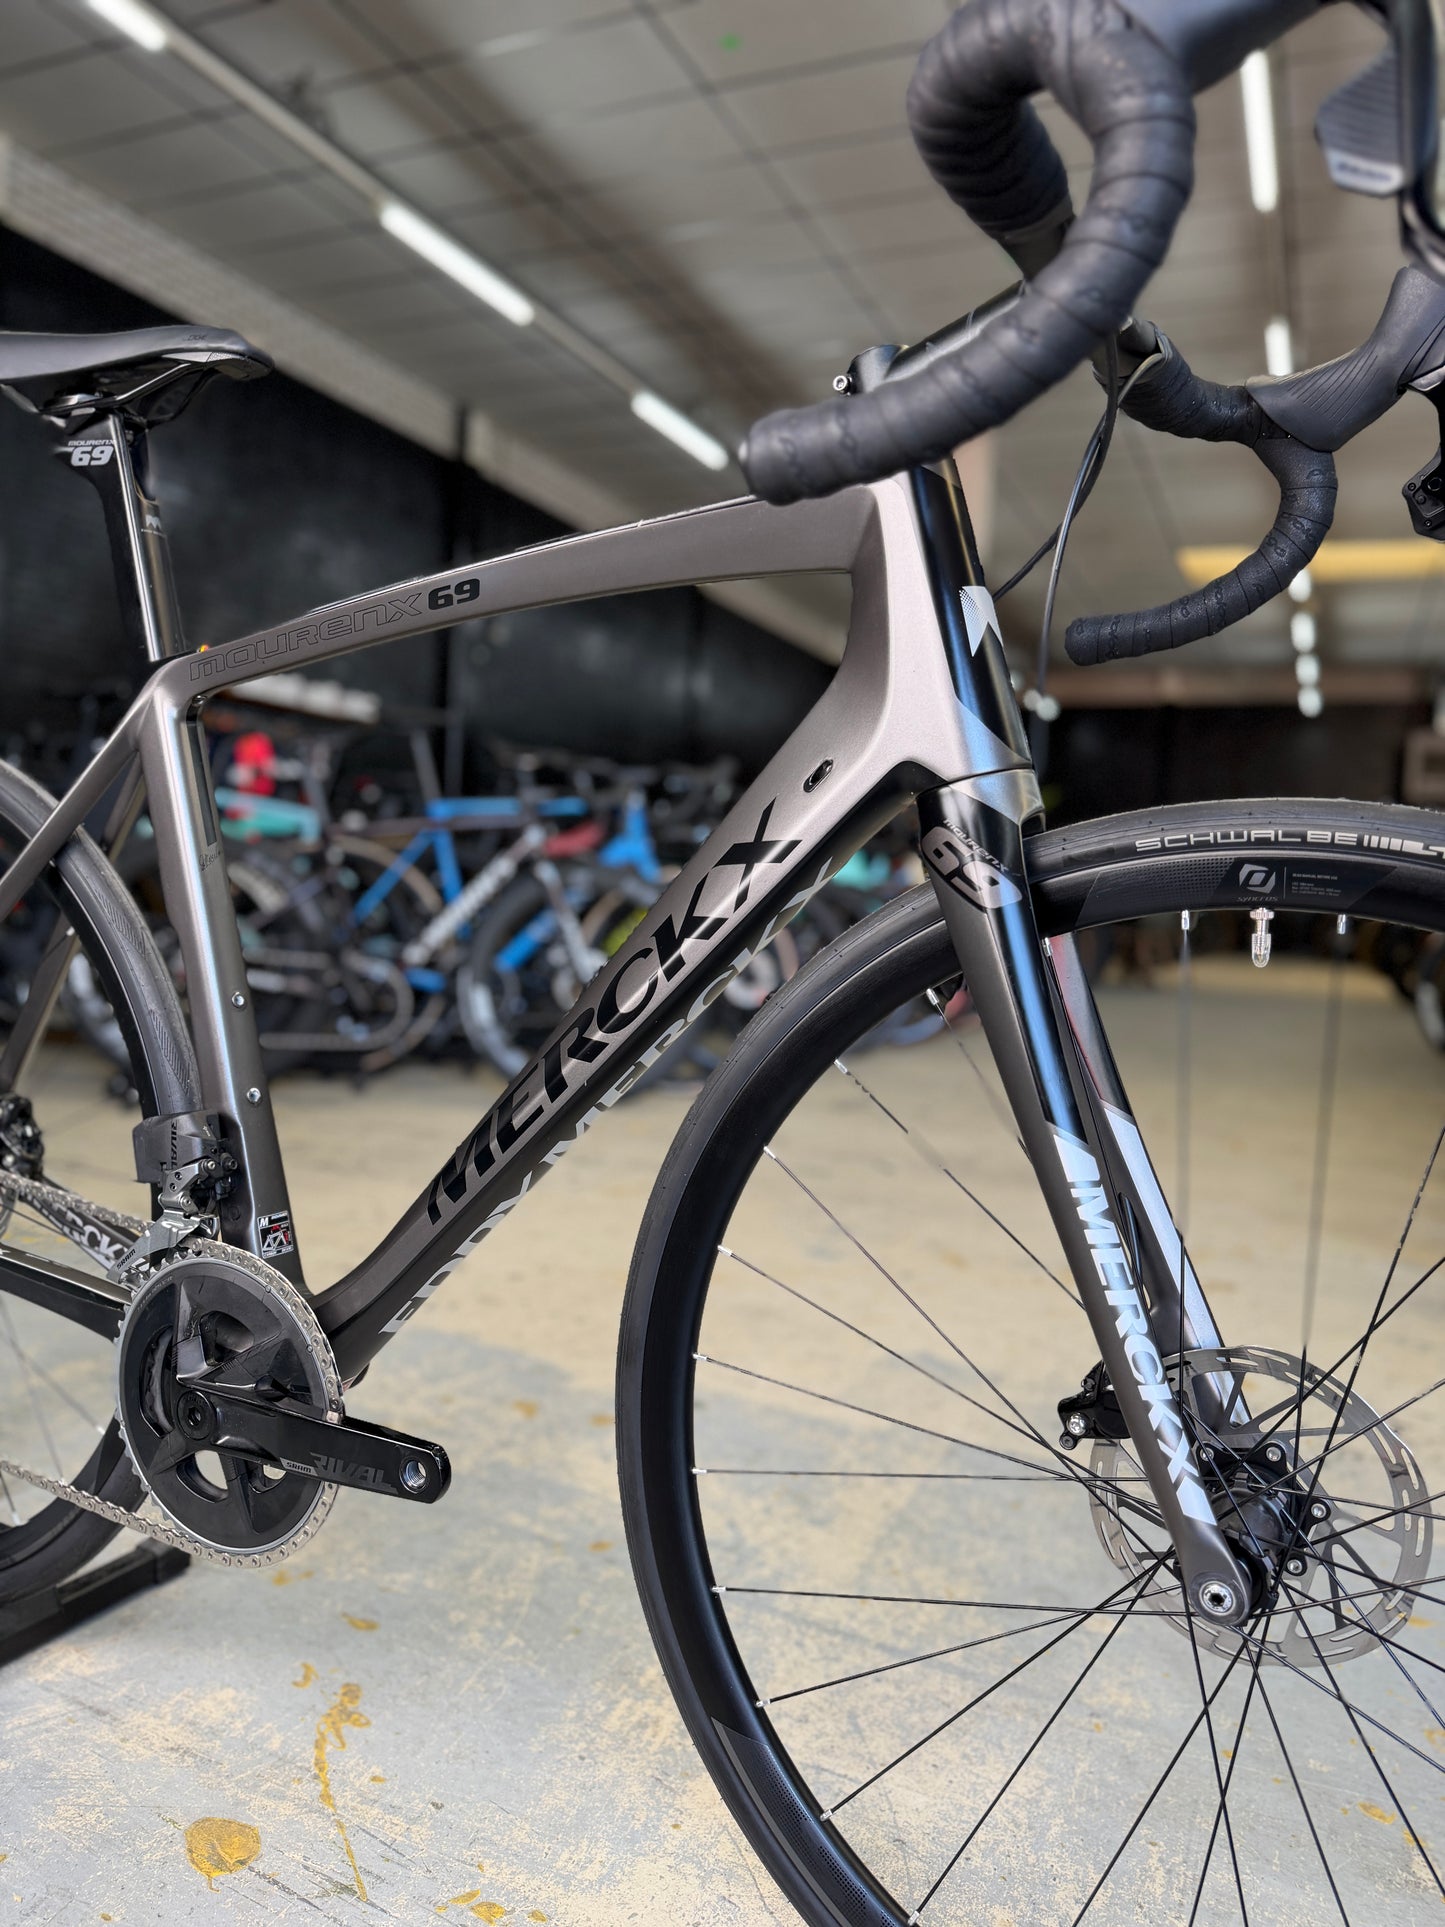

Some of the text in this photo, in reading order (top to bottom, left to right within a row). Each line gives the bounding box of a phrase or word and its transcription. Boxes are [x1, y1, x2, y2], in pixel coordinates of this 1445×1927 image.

[70, 446, 114, 467] 69
[427, 578, 481, 611] 69
[1135, 829, 1358, 852] SCHWALBE
[921, 826, 1023, 909] 69
[427, 797, 803, 1226] MERCKX
[116, 1248, 136, 1271] SRAM
[1069, 1182, 1198, 1483] MERCKX
[286, 1452, 399, 1495] SRAM RIVAL
